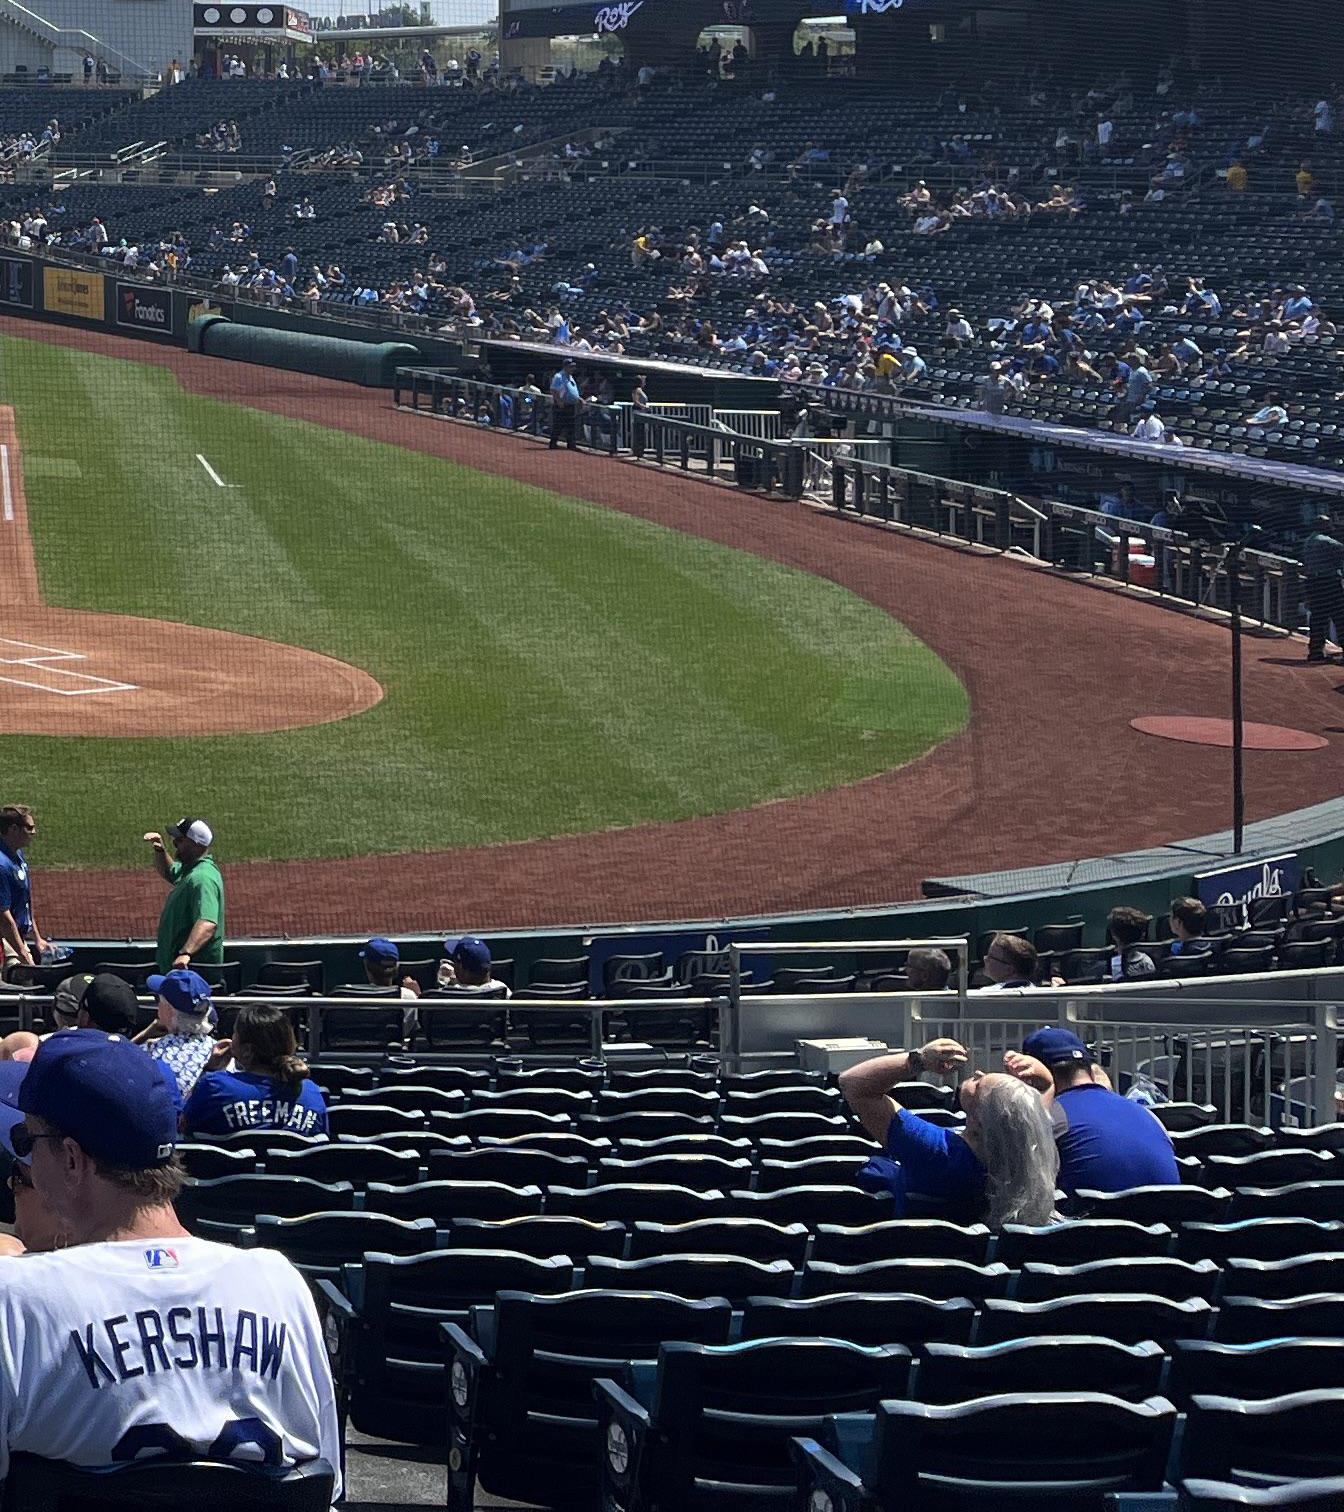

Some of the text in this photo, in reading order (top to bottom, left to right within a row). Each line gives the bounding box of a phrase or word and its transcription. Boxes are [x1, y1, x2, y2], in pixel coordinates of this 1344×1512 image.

[134, 299, 165, 323] Fanatics
[223, 1099, 321, 1133] FREEMAN
[71, 1306, 287, 1389] KERSHAW
